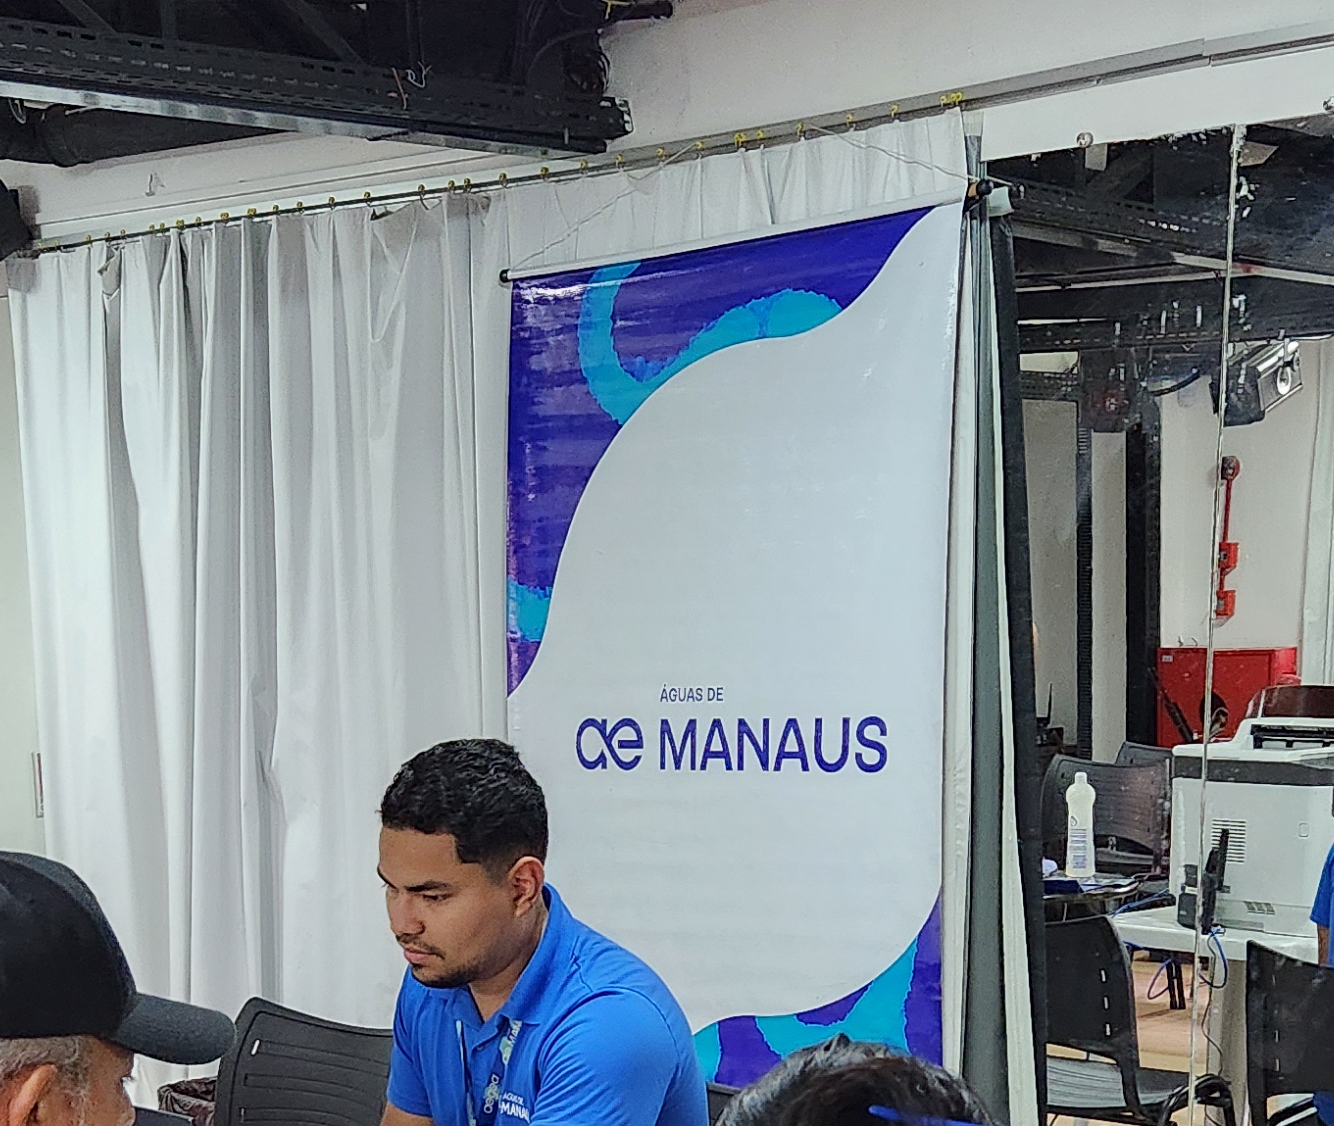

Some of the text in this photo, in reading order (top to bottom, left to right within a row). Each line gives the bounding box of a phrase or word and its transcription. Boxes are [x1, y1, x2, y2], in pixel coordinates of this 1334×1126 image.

[660, 684, 724, 703] ÁGUAS DE
[660, 716, 888, 772] MANAUS
